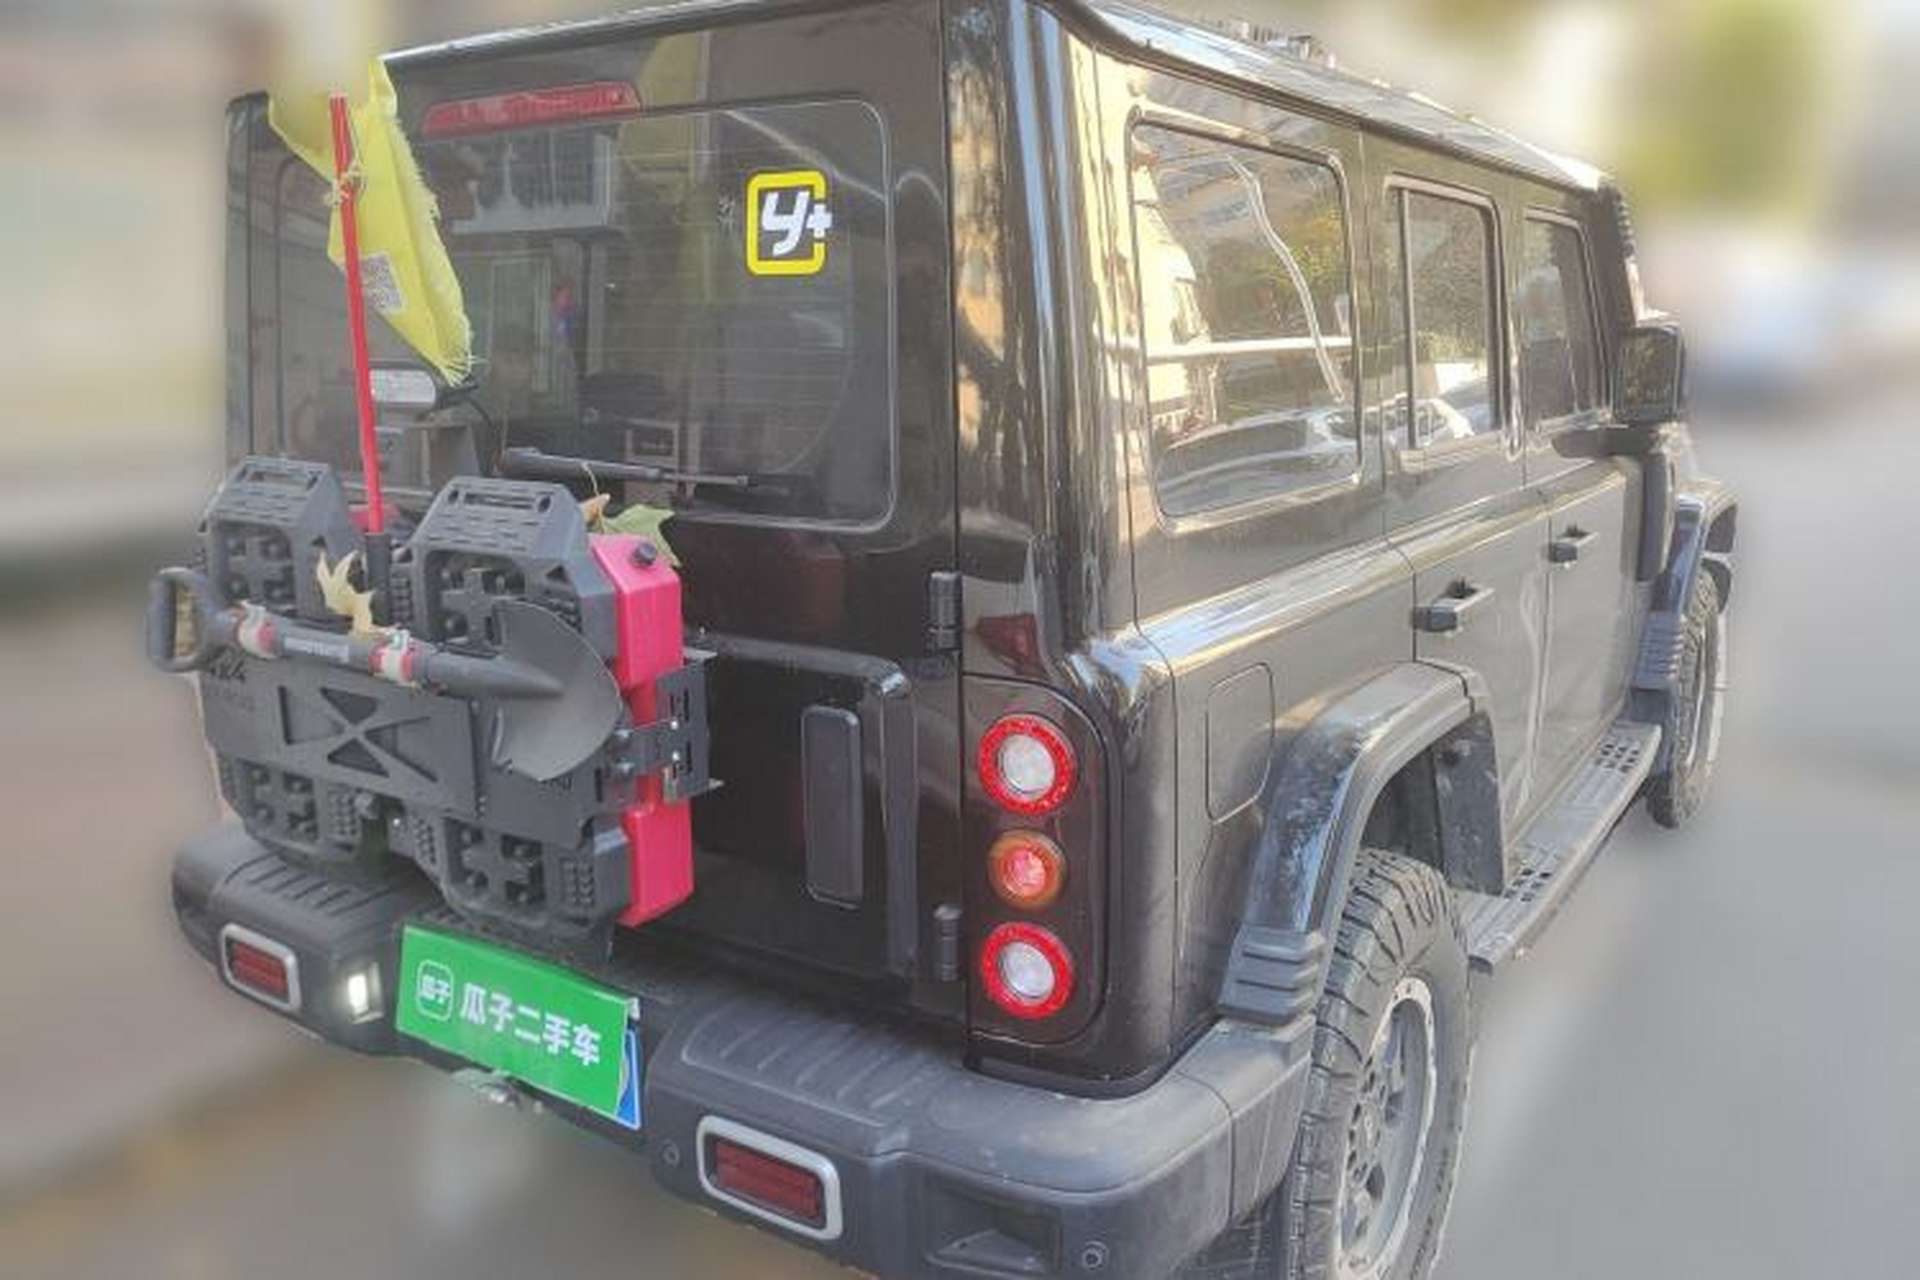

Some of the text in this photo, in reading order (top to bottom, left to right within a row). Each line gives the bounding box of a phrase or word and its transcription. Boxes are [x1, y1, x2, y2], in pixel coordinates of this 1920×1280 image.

[459, 982, 601, 1066] 瓜子二手车
